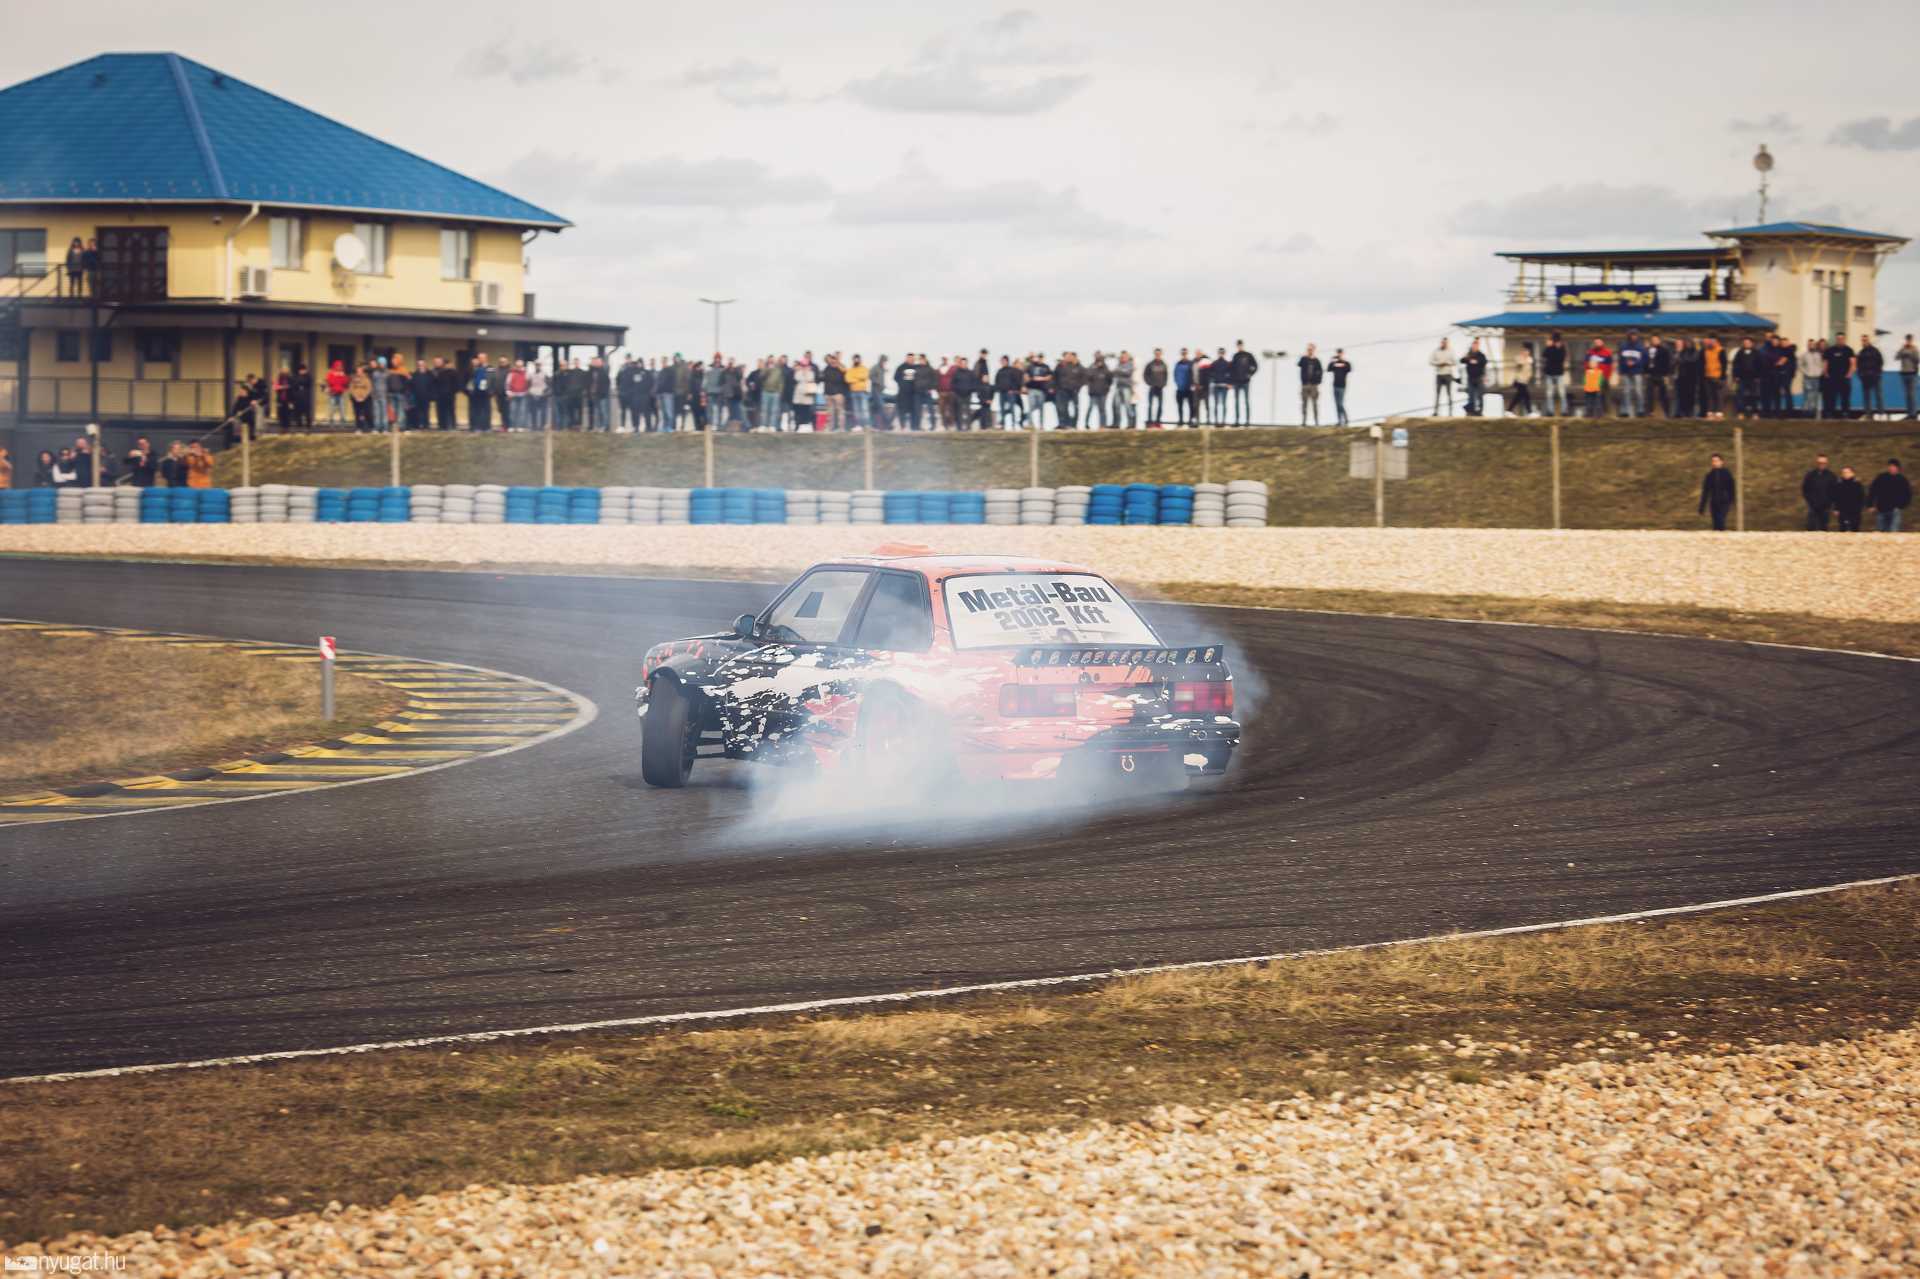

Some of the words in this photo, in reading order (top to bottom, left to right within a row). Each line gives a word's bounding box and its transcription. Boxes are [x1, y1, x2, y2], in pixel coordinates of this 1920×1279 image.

[958, 582, 1112, 613] Metál-Bau
[994, 606, 1066, 630] 2002
[1065, 605, 1111, 624] Kft
